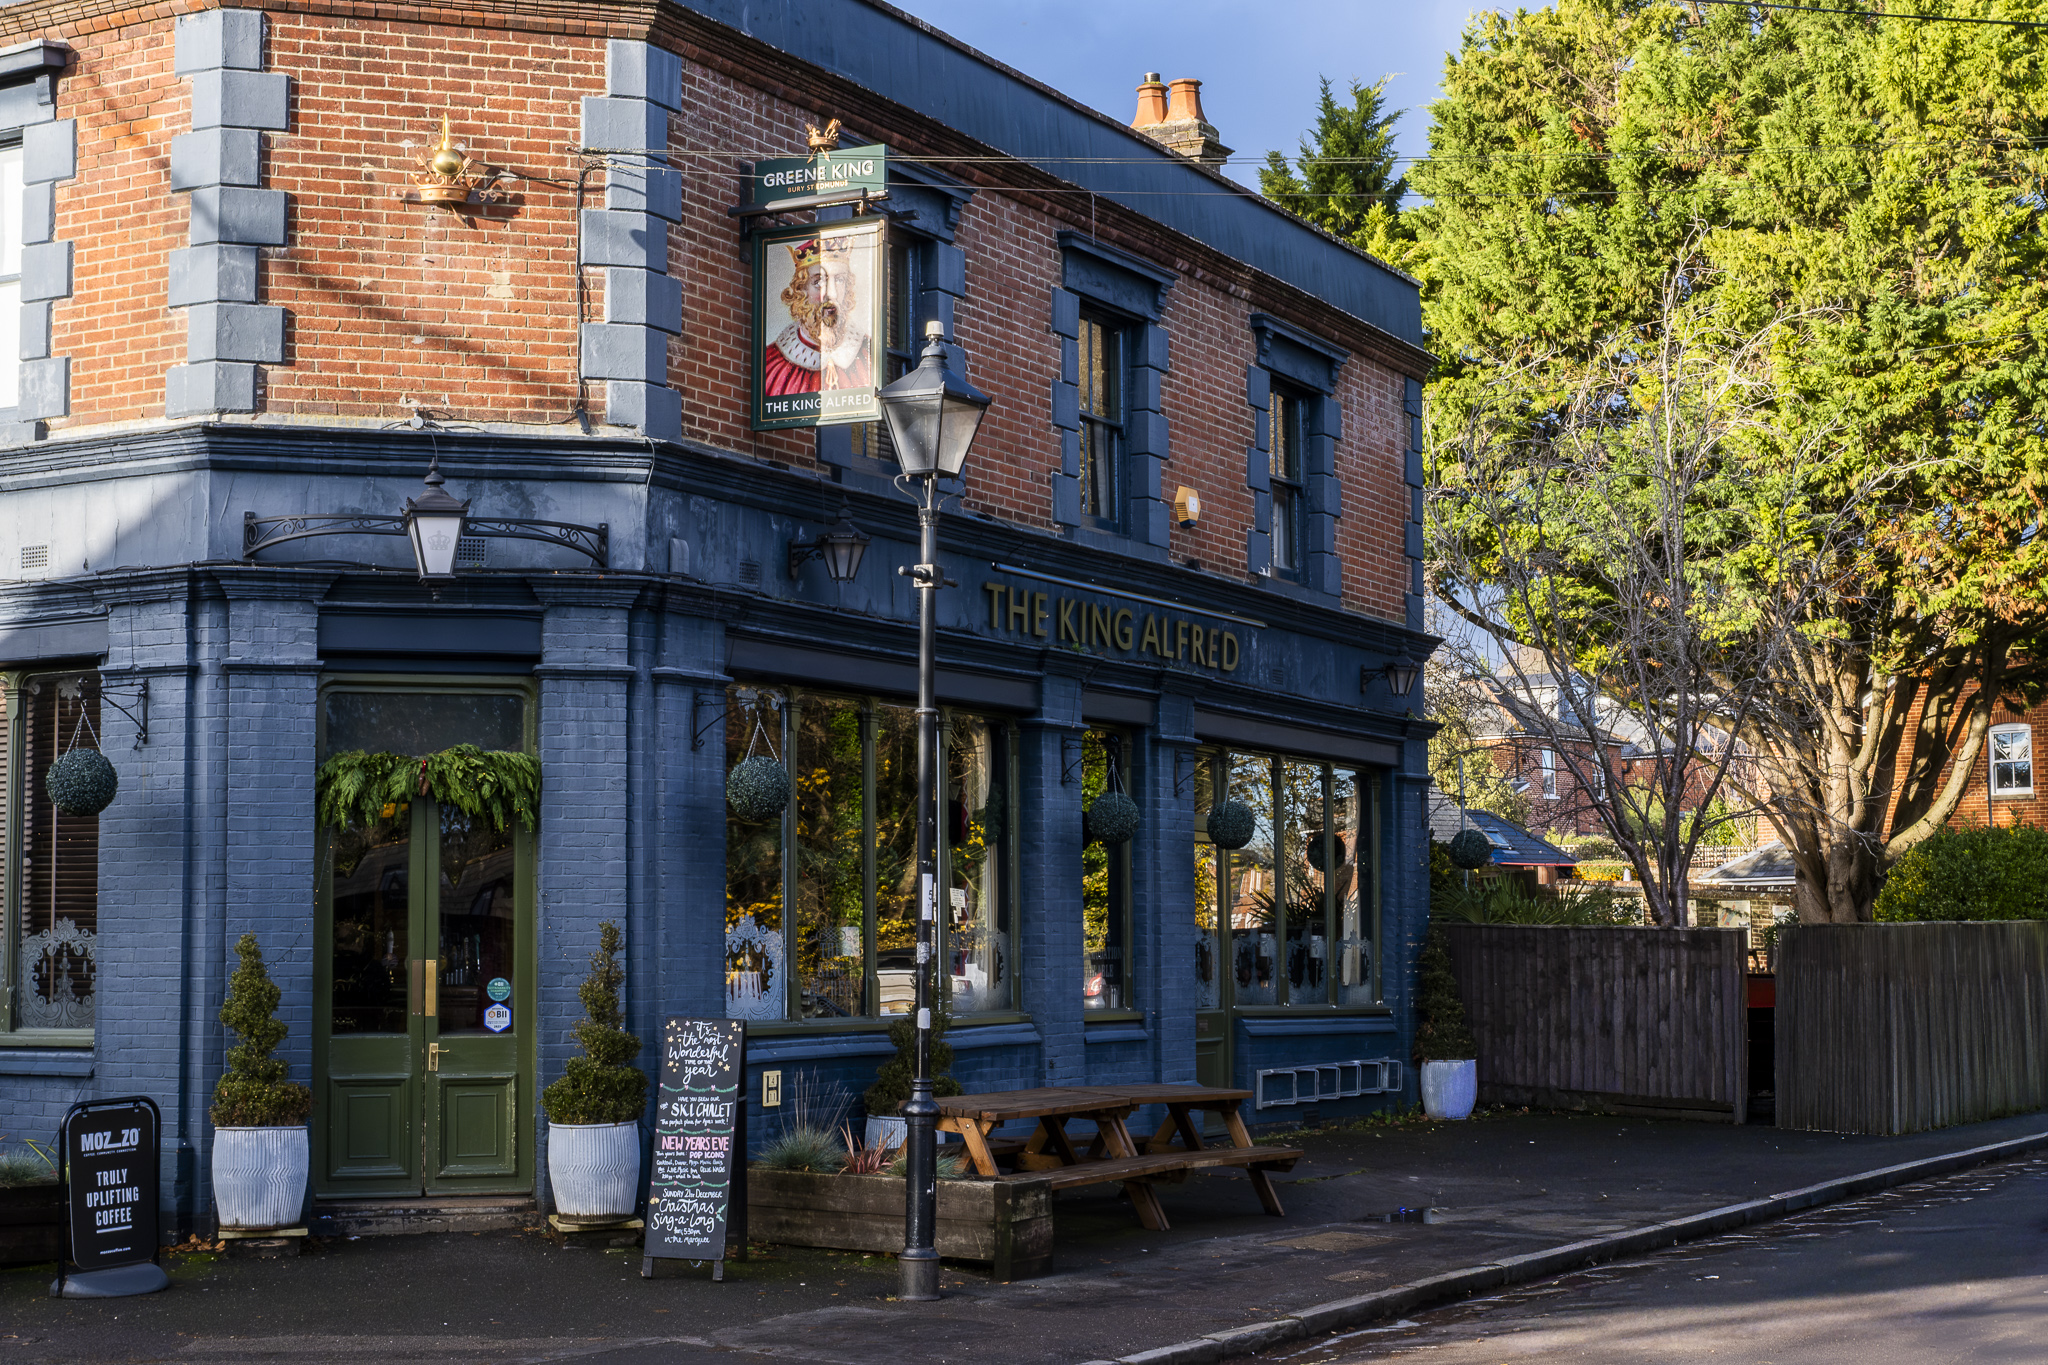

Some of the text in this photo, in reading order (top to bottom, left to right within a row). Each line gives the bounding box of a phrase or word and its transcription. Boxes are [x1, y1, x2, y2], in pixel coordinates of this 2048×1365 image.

[764, 160, 874, 187] GREENE KING
[816, 180, 848, 190] EDMUNDS
[766, 394, 872, 413] THE KING ALFRED
[984, 581, 1239, 672] THE KING ALFRED
[677, 1031, 700, 1047] the
[683, 1064, 717, 1084] year
[696, 1102, 733, 1117] CHALET
[662, 1136, 683, 1150] NEW
[712, 1136, 729, 1151] EVE
[689, 1151, 703, 1159] POP
[704, 1151, 725, 1159] ICONS
[96, 1168, 128, 1186] TRULY
[86, 1186, 139, 1208] UPLIFTING
[662, 1188, 684, 1198] SUNDAY
[695, 1188, 723, 1198] DECEMBER
[659, 1198, 714, 1214] Christmas
[96, 1207, 132, 1226] COFFEE
